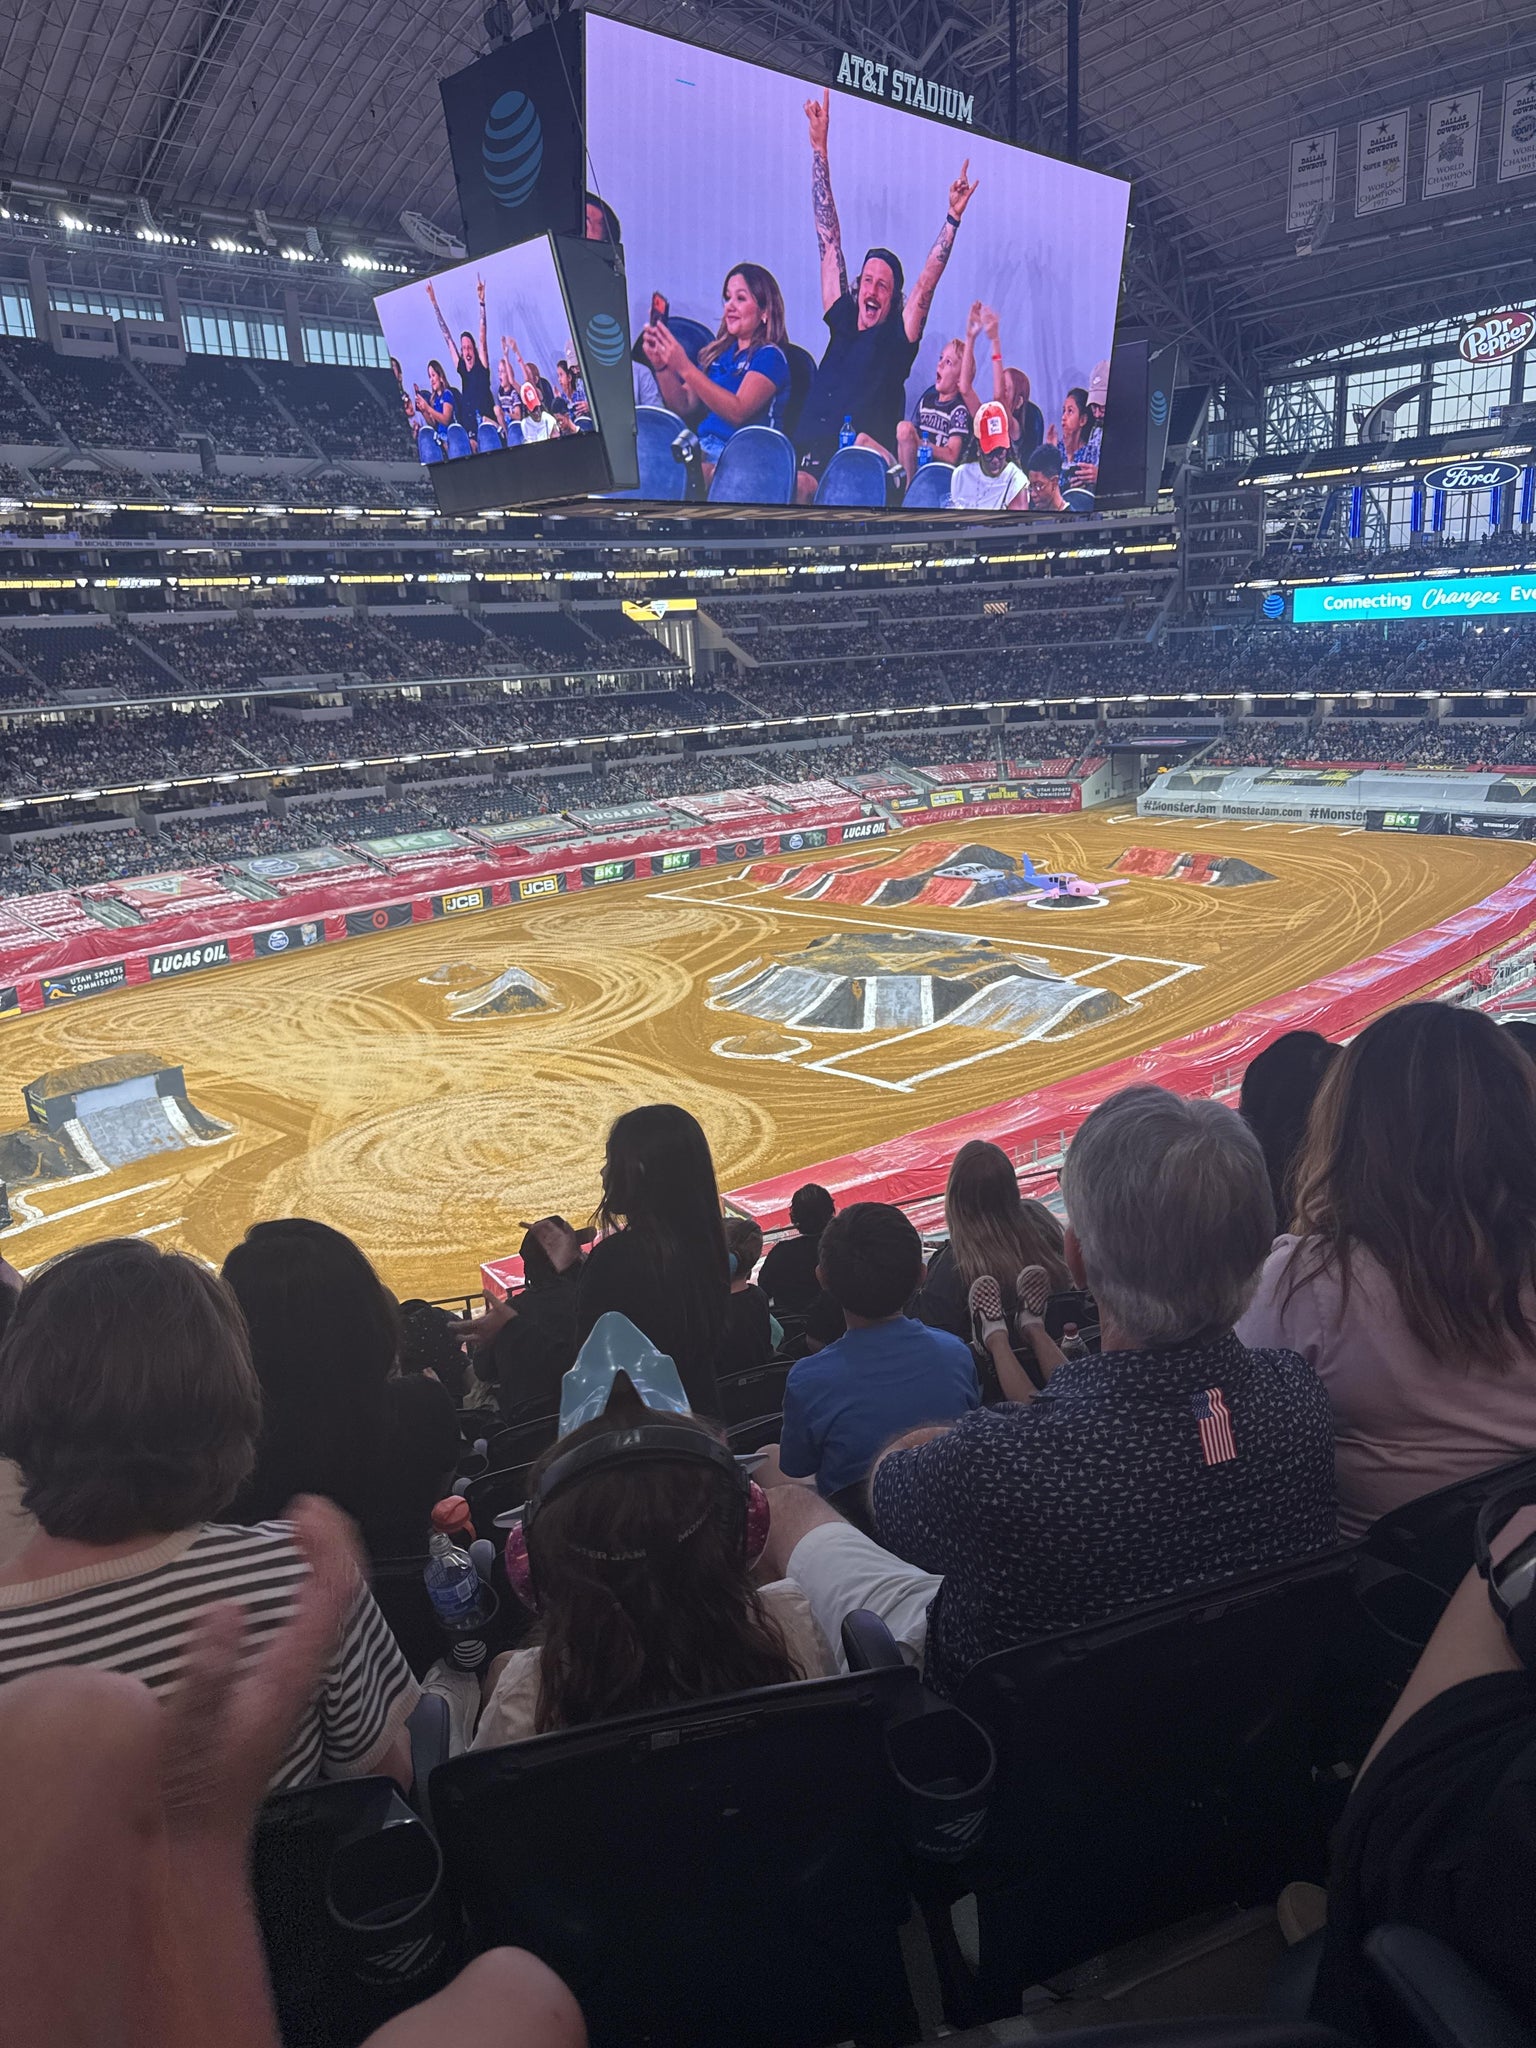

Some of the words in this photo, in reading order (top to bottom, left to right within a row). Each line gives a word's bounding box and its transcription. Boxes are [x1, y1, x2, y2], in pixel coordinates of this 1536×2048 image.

[836, 52, 889, 96] AT&T
[891, 70, 975, 125] STADIUM
[1436, 121, 1470, 136] COWBOYS
[1440, 114, 1467, 127] DALLAS
[1366, 140, 1398, 155] COWBOYS
[1370, 134, 1396, 147] DALLAS
[1298, 160, 1328, 173] COWBOYS
[1301, 153, 1325, 165] DALLAS
[1436, 162, 1465, 175] WORLD
[1427, 169, 1472, 186] CHAMPIONS
[1367, 180, 1395, 193] WORLD
[1359, 187, 1402, 204] CHAMPIONS
[1485, 317, 1513, 340] Dr
[1468, 321, 1532, 360] Pepper
[1441, 465, 1501, 488] Ford
[1323, 592, 1412, 611] Connecting
[1422, 587, 1501, 610] Changes
[585, 808, 631, 821] LUCAS
[634, 805, 657, 816] OIL
[1143, 799, 1216, 815] #MonsterJam
[1222, 804, 1303, 818] MonsterJam.com
[1384, 813, 1420, 826] BKT
[843, 823, 872, 840] LUCAS
[872, 822, 886, 835] OIL
[663, 853, 690, 868] BKT
[595, 863, 623, 878] BKT
[523, 879, 555, 895] JCB
[446, 893, 480, 911] JCB
[152, 951, 202, 974] LUCAS
[204, 945, 227, 963] OIL
[70, 974, 93, 986] UTAH
[94, 966, 124, 979] SPORTS
[71, 975, 124, 993] COMMISSION
